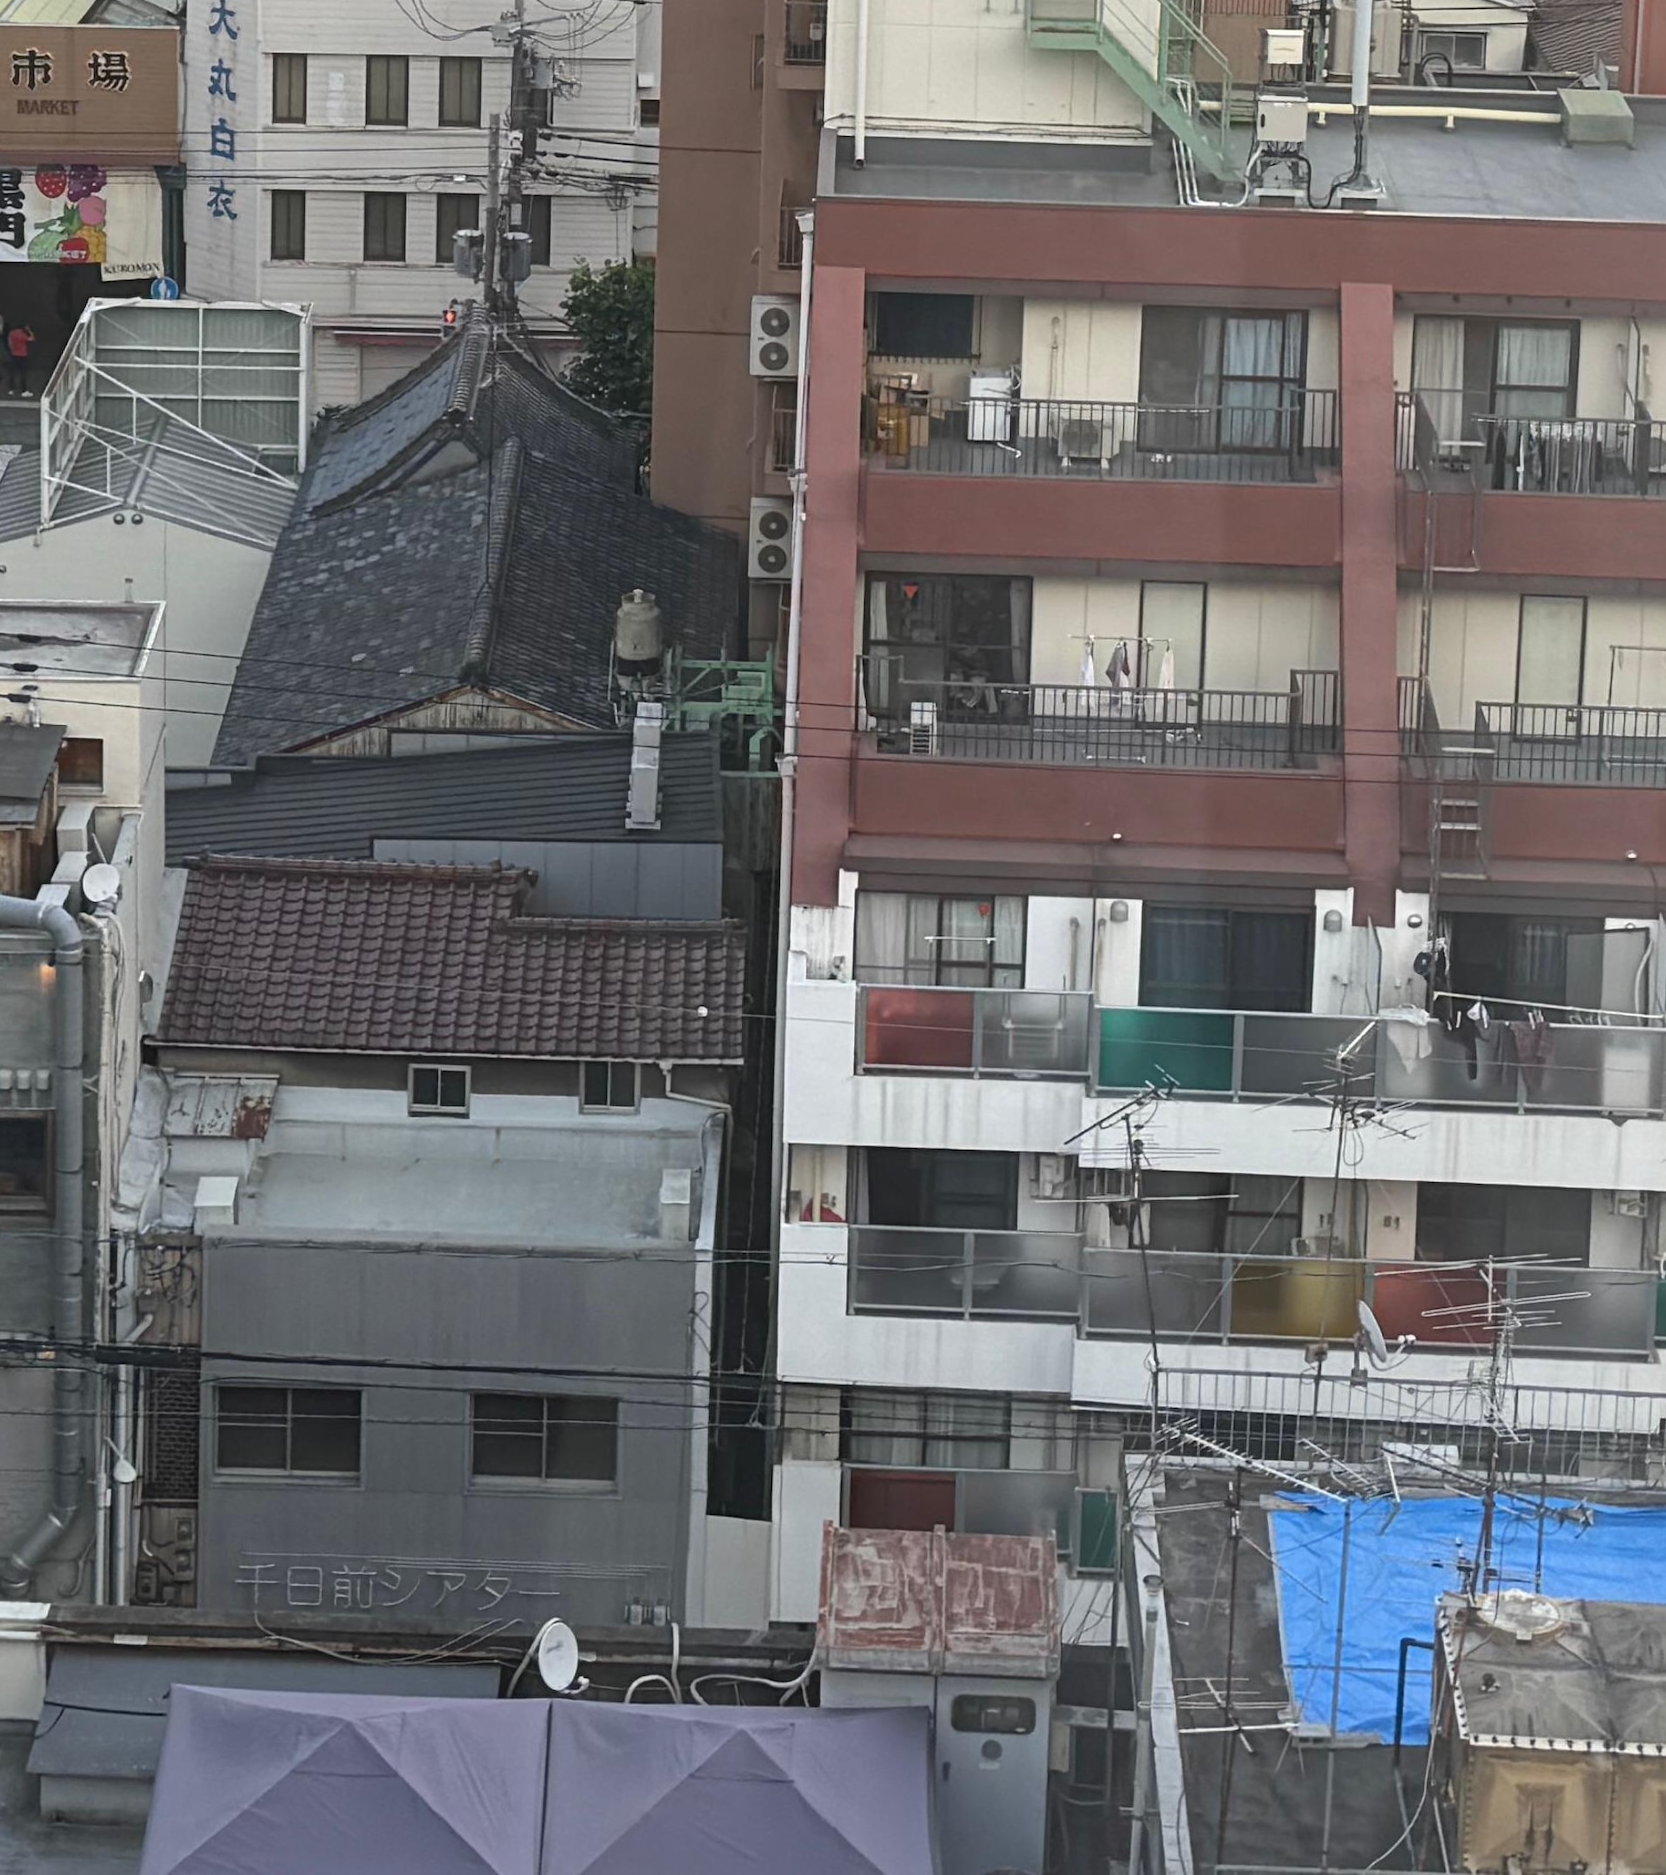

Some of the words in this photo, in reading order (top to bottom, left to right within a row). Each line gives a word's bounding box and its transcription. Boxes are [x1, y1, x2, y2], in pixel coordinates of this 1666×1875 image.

[17, 99, 80, 116] MARKET
[233, 1561, 561, 1612] 千日前シアター
